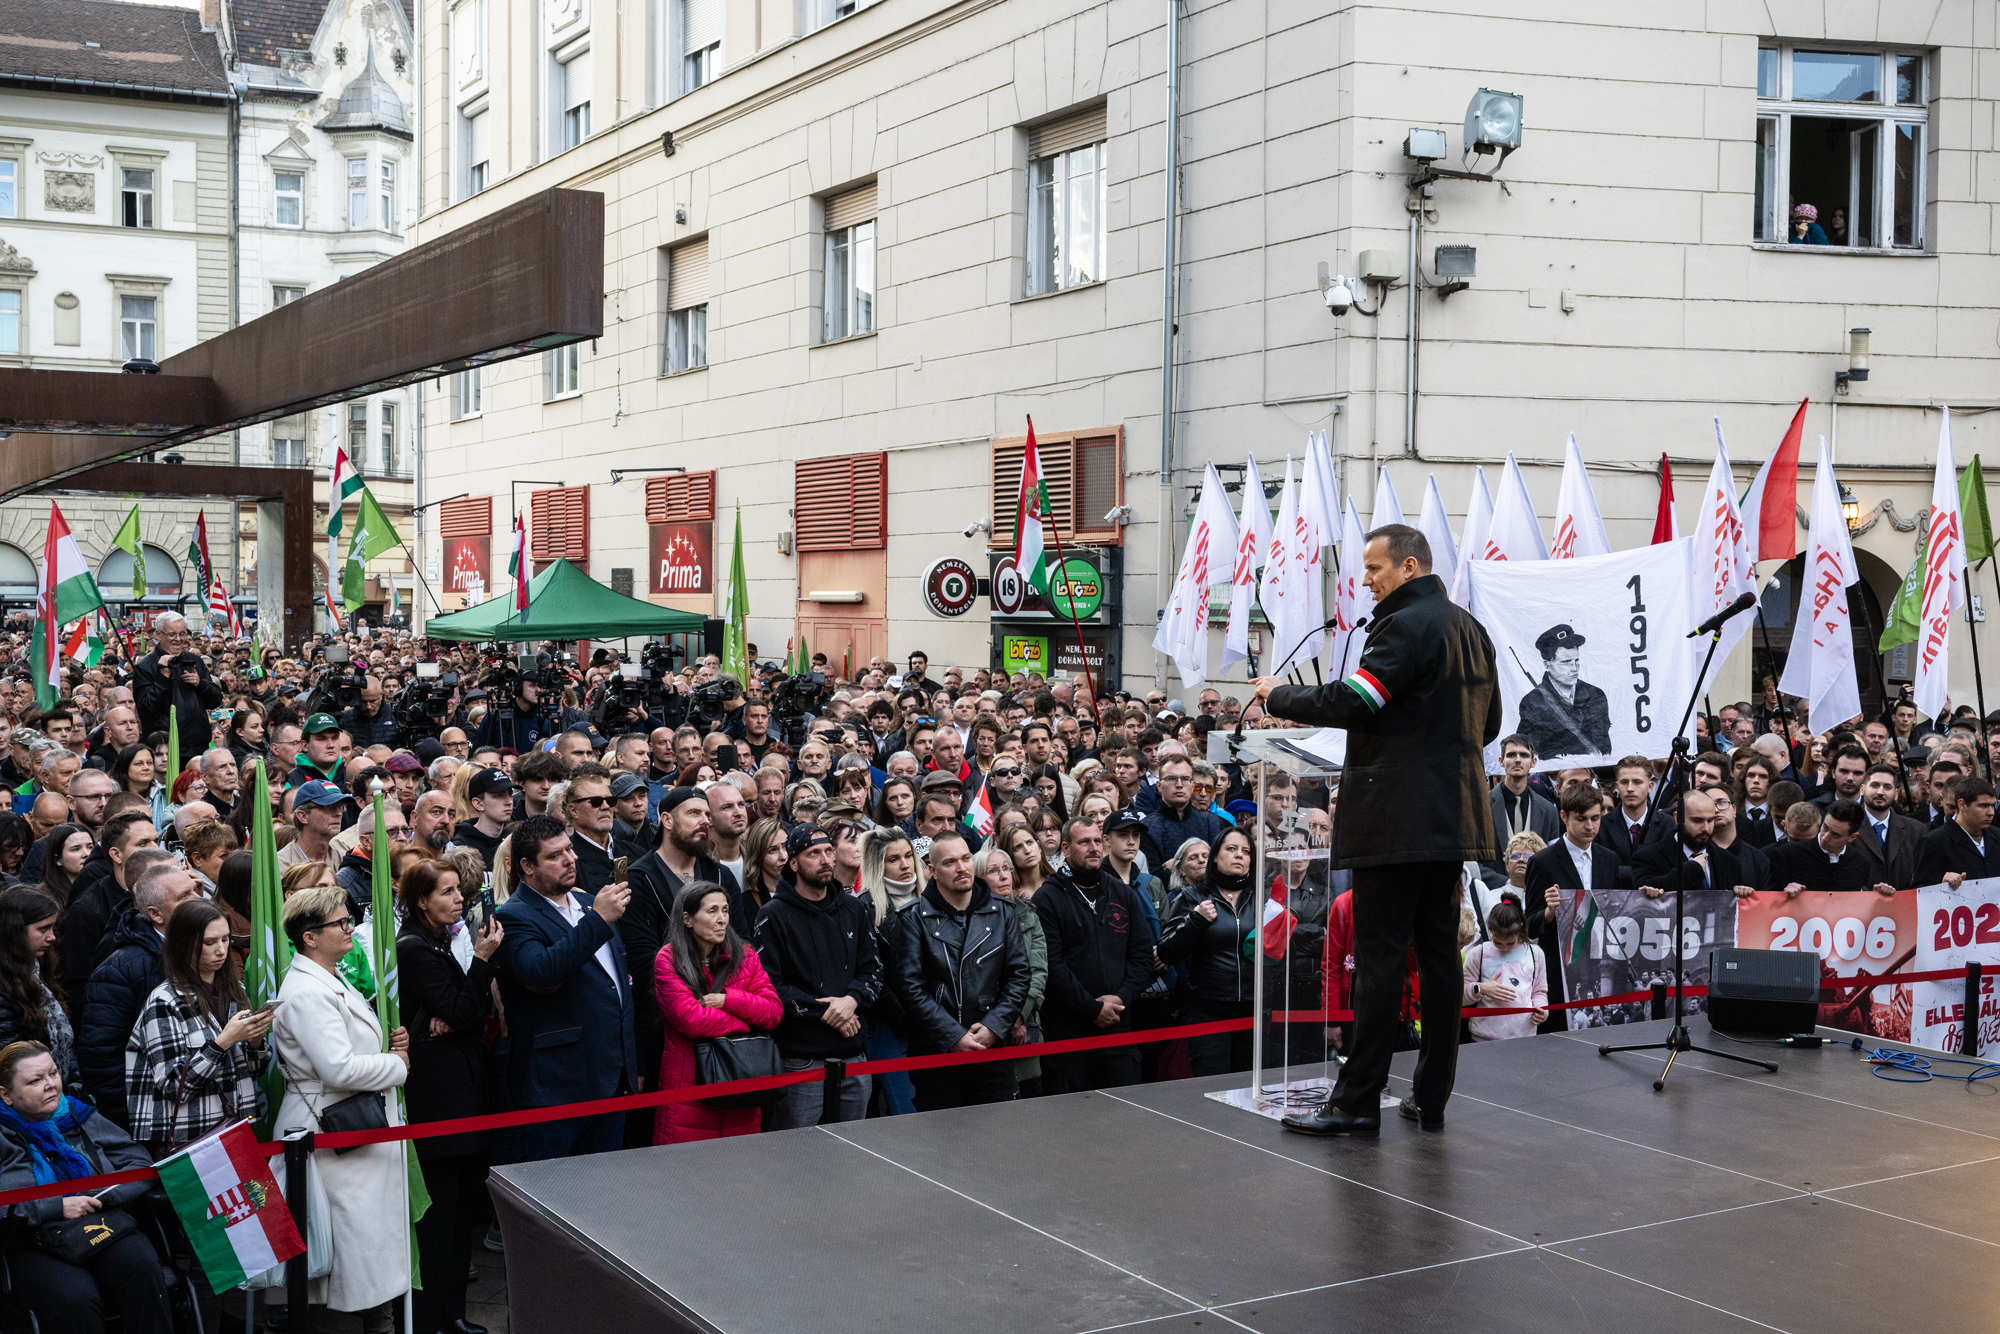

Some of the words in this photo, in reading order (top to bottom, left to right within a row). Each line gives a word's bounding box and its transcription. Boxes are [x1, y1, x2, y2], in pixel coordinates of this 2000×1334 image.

[659, 558, 702, 589] Príma
[936, 561, 971, 575] NEMZETI
[949, 582, 960, 594] T
[1002, 578, 1016, 596] 18
[930, 591, 975, 614] DOHÁNYBOLT
[1626, 574, 1652, 733] 1956
[1589, 916, 1701, 961] 1956
[1769, 916, 1896, 961] 2006
[1933, 902, 2000, 951] 202
[89, 1230, 112, 1247] PUMA
